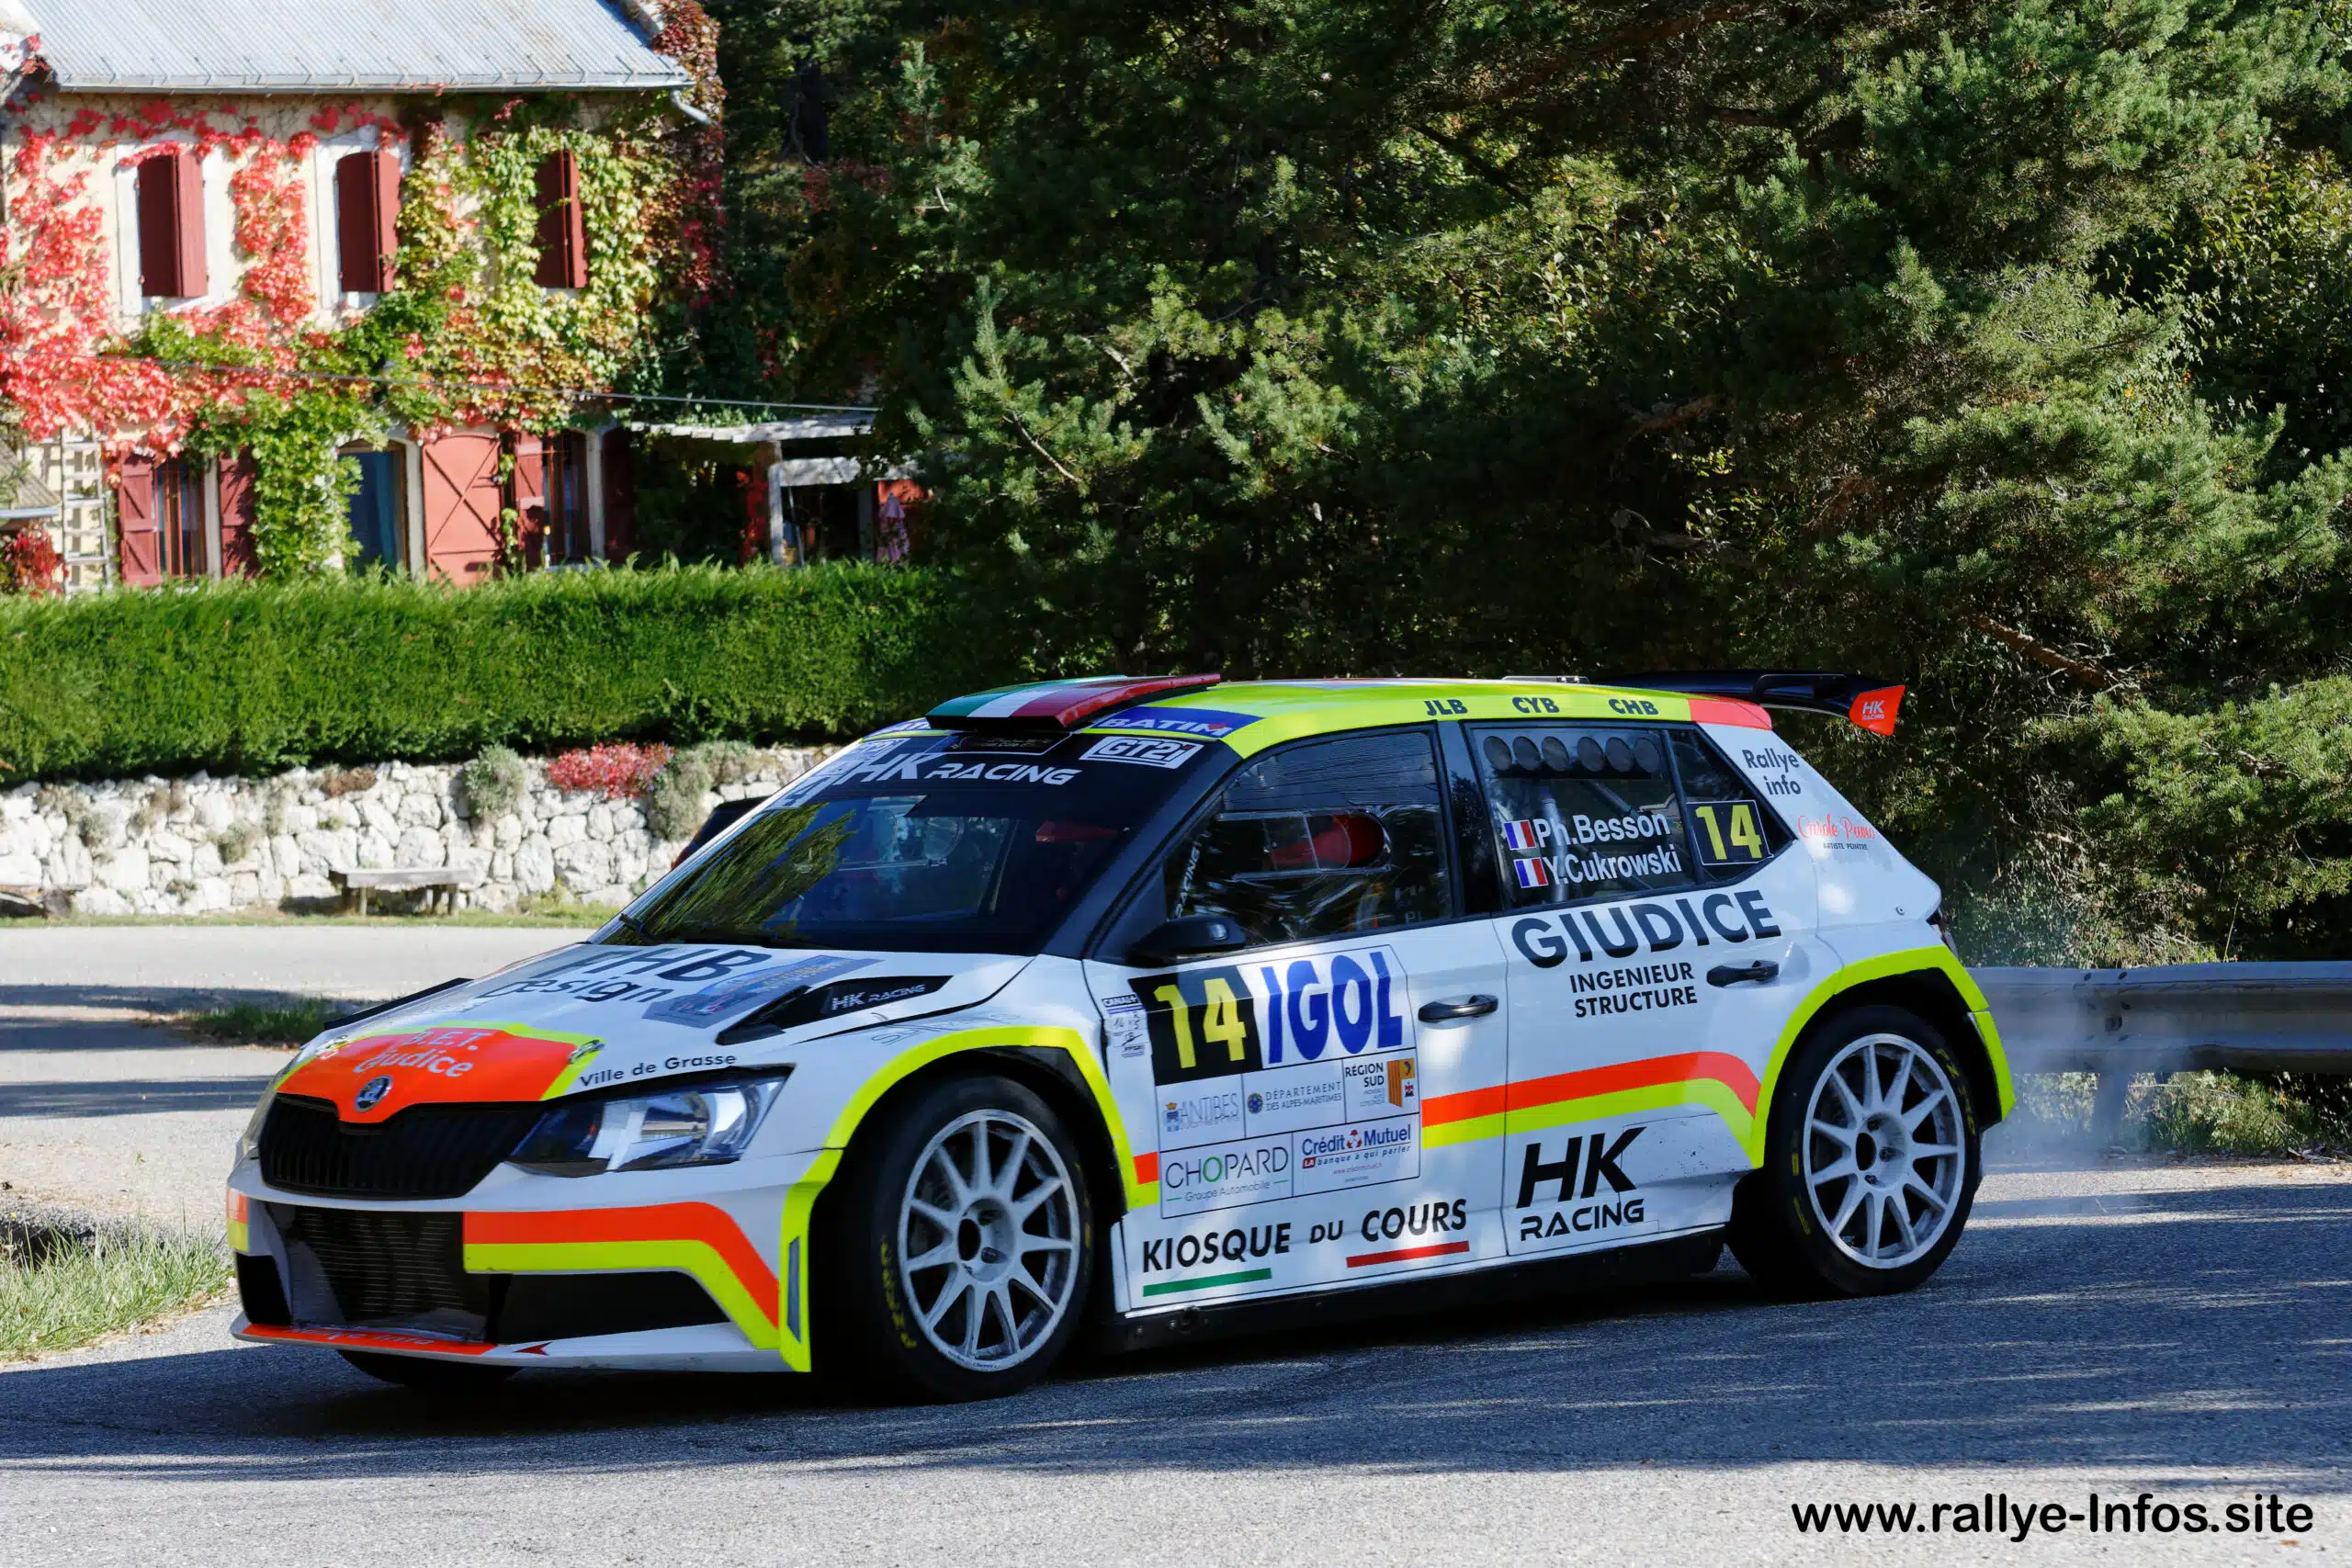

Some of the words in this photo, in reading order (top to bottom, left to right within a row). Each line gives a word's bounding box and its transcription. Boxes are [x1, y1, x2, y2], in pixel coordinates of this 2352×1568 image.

[1424, 698, 1468, 716] JLB
[1512, 696, 1560, 714] CYB
[1609, 698, 1658, 715] CHB
[1861, 700, 1885, 715] HK
[1098, 718, 1233, 739] BATIM
[831, 752, 950, 787] HK
[922, 762, 1083, 785] RACING
[1742, 748, 1800, 773] Rallye
[1763, 774, 1802, 795] info
[1695, 804, 1762, 860] 14
[1544, 843, 1682, 886] Y.Cukrowski
[1511, 889, 1781, 968] GIUDICE
[476, 976, 674, 1003] Design
[1569, 962, 1696, 993] INGENIEUR
[831, 991, 866, 1010] HK
[1261, 951, 1403, 1065] IGOL
[1574, 986, 1698, 1018] STRUCTURE
[1153, 977, 1247, 1069] 14
[580, 1068, 624, 1087] Ville
[632, 1062, 657, 1076] de
[664, 1053, 738, 1070] Grasse
[1363, 1075, 1385, 1088] SUD
[1265, 1081, 1342, 1101] DÉPARTEMENT
[1302, 1134, 1345, 1156] Crédit
[1363, 1124, 1411, 1147] Mutuel
[1165, 1146, 1289, 1189] CHOPARD
[1516, 1126, 1646, 1209] HK
[1521, 1198, 1645, 1241] RACING
[1142, 1222, 1292, 1273] KIOSQUE
[1309, 1220, 1344, 1245] DU
[1361, 1199, 1467, 1243] COURS
